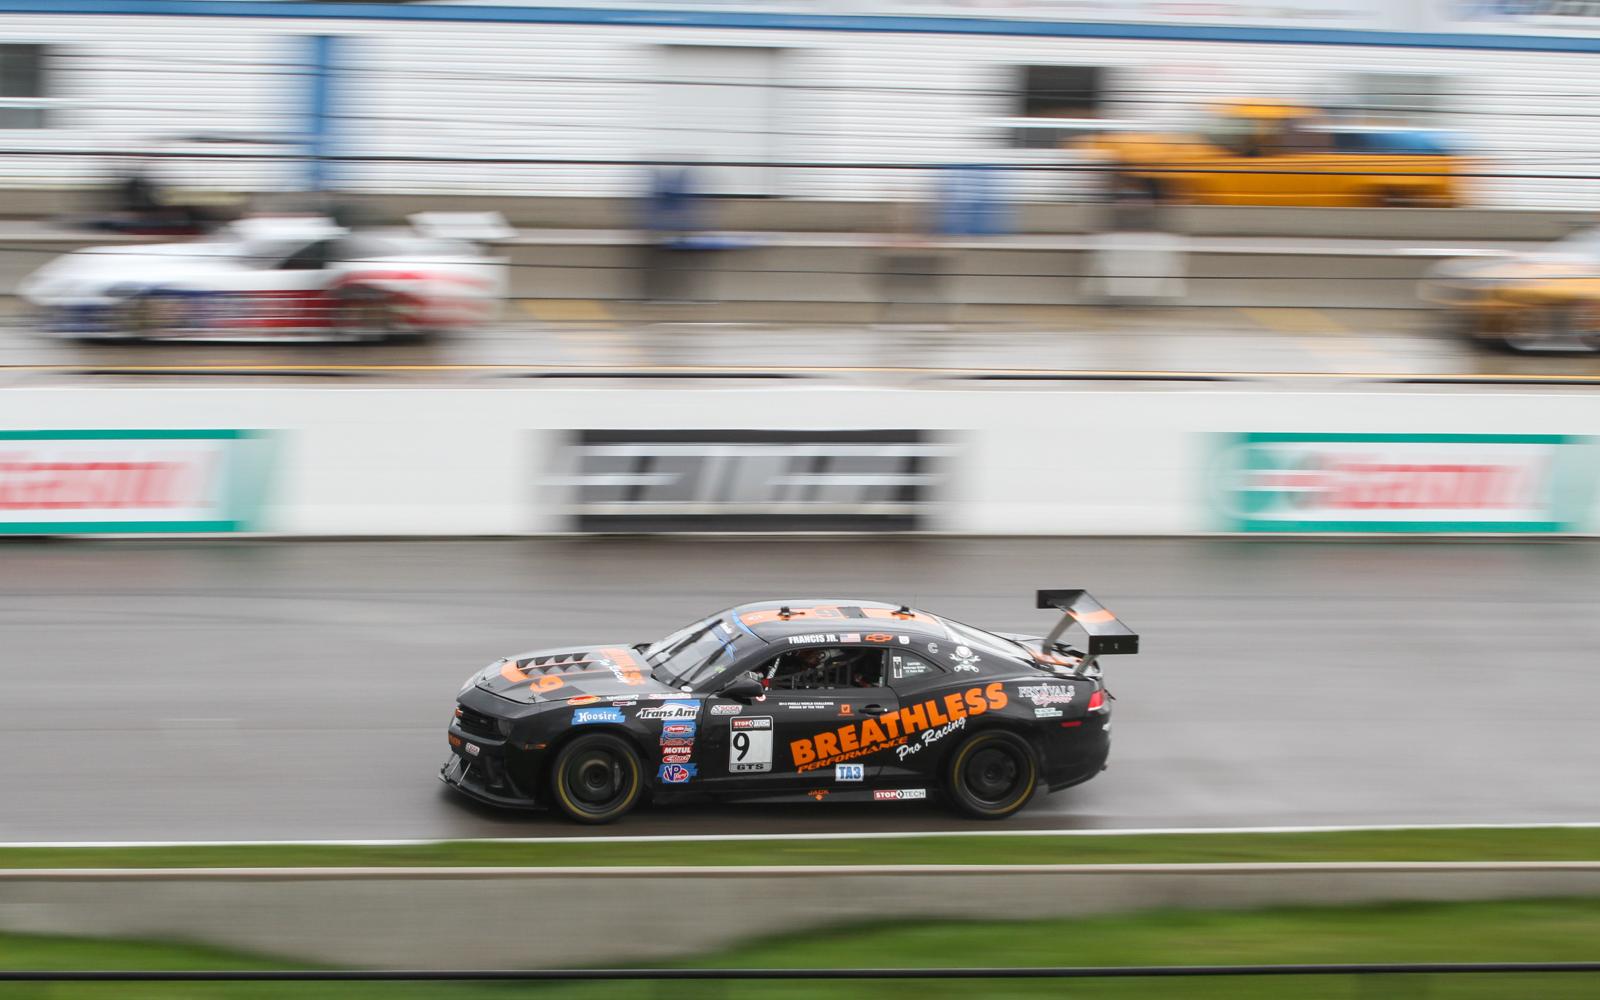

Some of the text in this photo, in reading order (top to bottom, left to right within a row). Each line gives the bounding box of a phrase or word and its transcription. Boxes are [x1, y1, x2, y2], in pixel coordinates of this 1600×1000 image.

[788, 633, 839, 644] FRANCIS JR.
[577, 711, 617, 722] Hoosier
[640, 707, 696, 718] Trans Am
[790, 682, 1008, 766] BREATHLESS
[896, 716, 966, 761] Pro Racing
[733, 732, 750, 762] 9
[797, 736, 908, 773] PERFORMANCE
[665, 765, 680, 781] VP
[838, 765, 862, 779] TA3
